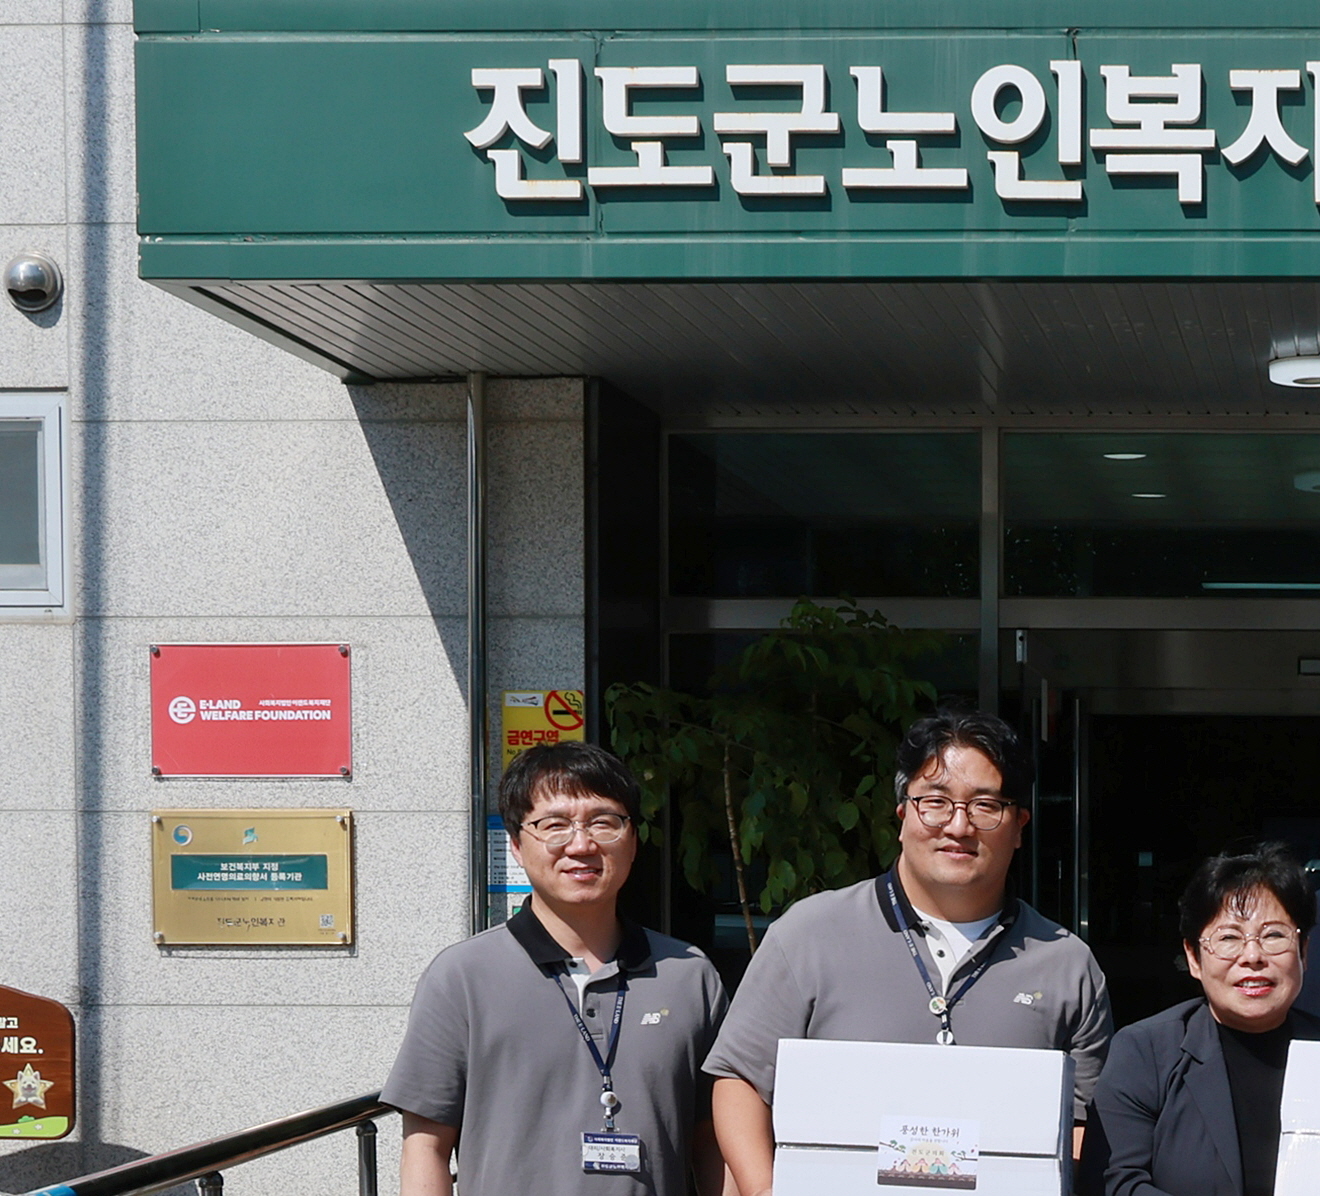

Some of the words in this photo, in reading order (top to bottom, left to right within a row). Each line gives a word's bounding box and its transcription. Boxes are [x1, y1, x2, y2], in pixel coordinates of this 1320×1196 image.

[201, 710, 253, 720] WELFARE
[255, 710, 331, 720] FOUNDATION
[507, 730, 559, 746] 금연구역
[220, 862, 259, 871] 보건복지부
[263, 862, 279, 871] 지정
[271, 872, 302, 882] 등록기관
[1, 1036, 44, 1054] 세요.
[900, 1125, 928, 1136] 풍성한
[932, 1127, 960, 1138] 한가위
